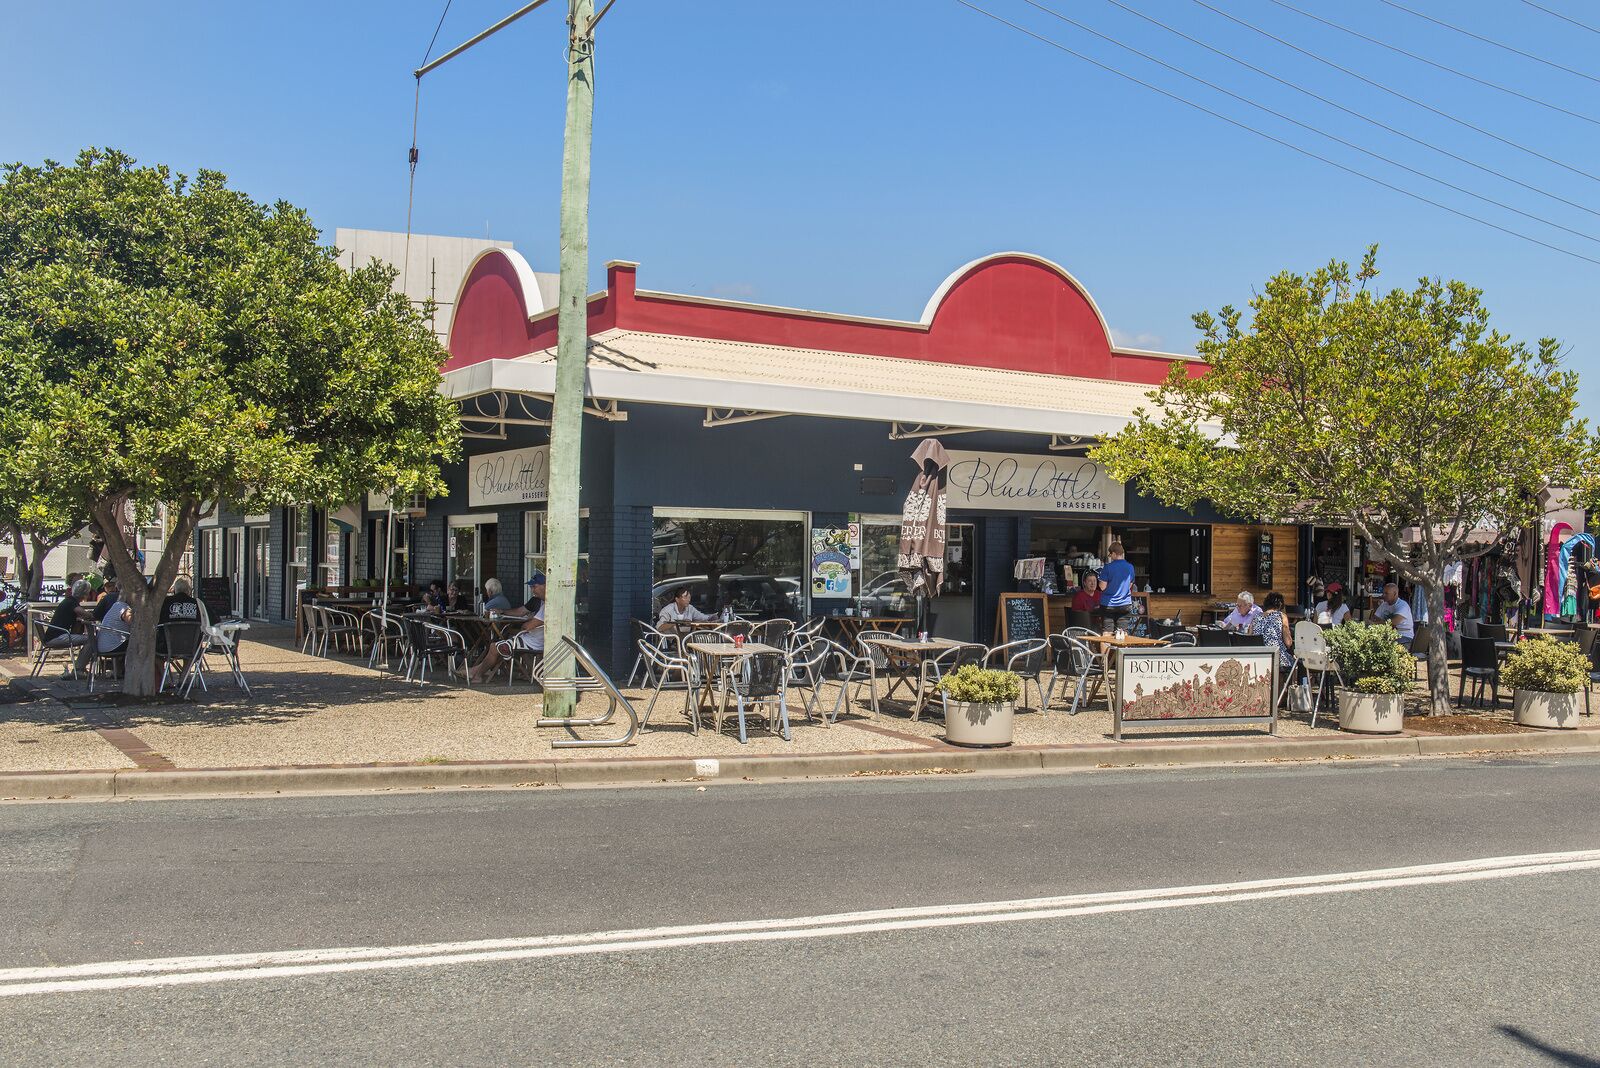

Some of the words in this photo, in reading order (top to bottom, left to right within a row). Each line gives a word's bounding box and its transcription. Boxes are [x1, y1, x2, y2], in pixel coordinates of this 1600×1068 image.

[476, 451, 545, 499] Bluebottles
[949, 457, 1101, 502] Bluebottles
[522, 491, 548, 500] BRASSERIE
[1056, 501, 1106, 510] BRASSERIE
